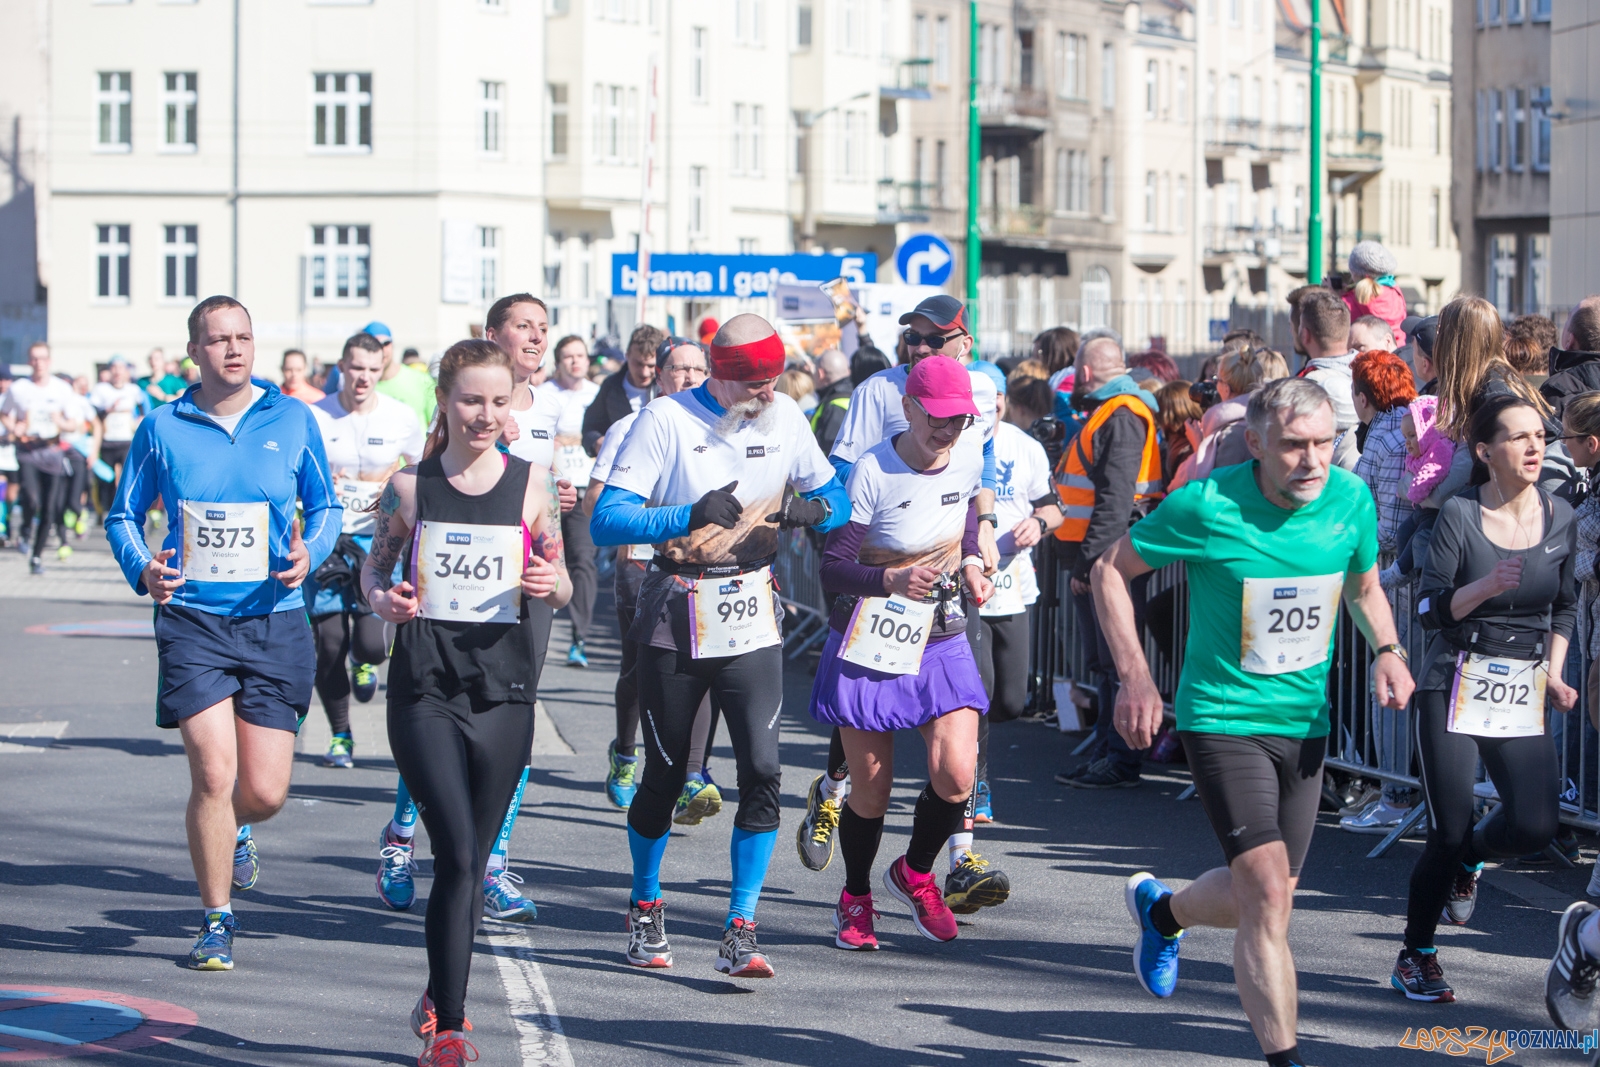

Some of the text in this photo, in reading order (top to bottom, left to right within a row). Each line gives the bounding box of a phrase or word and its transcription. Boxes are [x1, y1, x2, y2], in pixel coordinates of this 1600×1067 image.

[621, 264, 713, 292] bama
[840, 257, 866, 283] 5
[197, 526, 254, 548] 5373
[434, 552, 503, 580] 3461
[452, 584, 484, 592] Karolina
[717, 596, 758, 623] 998
[1268, 606, 1321, 633] 205
[729, 622, 752, 631] Tadeusz
[870, 614, 923, 645] 1006
[884, 642, 900, 651] Irena
[1278, 636, 1310, 645] Grzegorz
[1473, 680, 1530, 705] 2012
